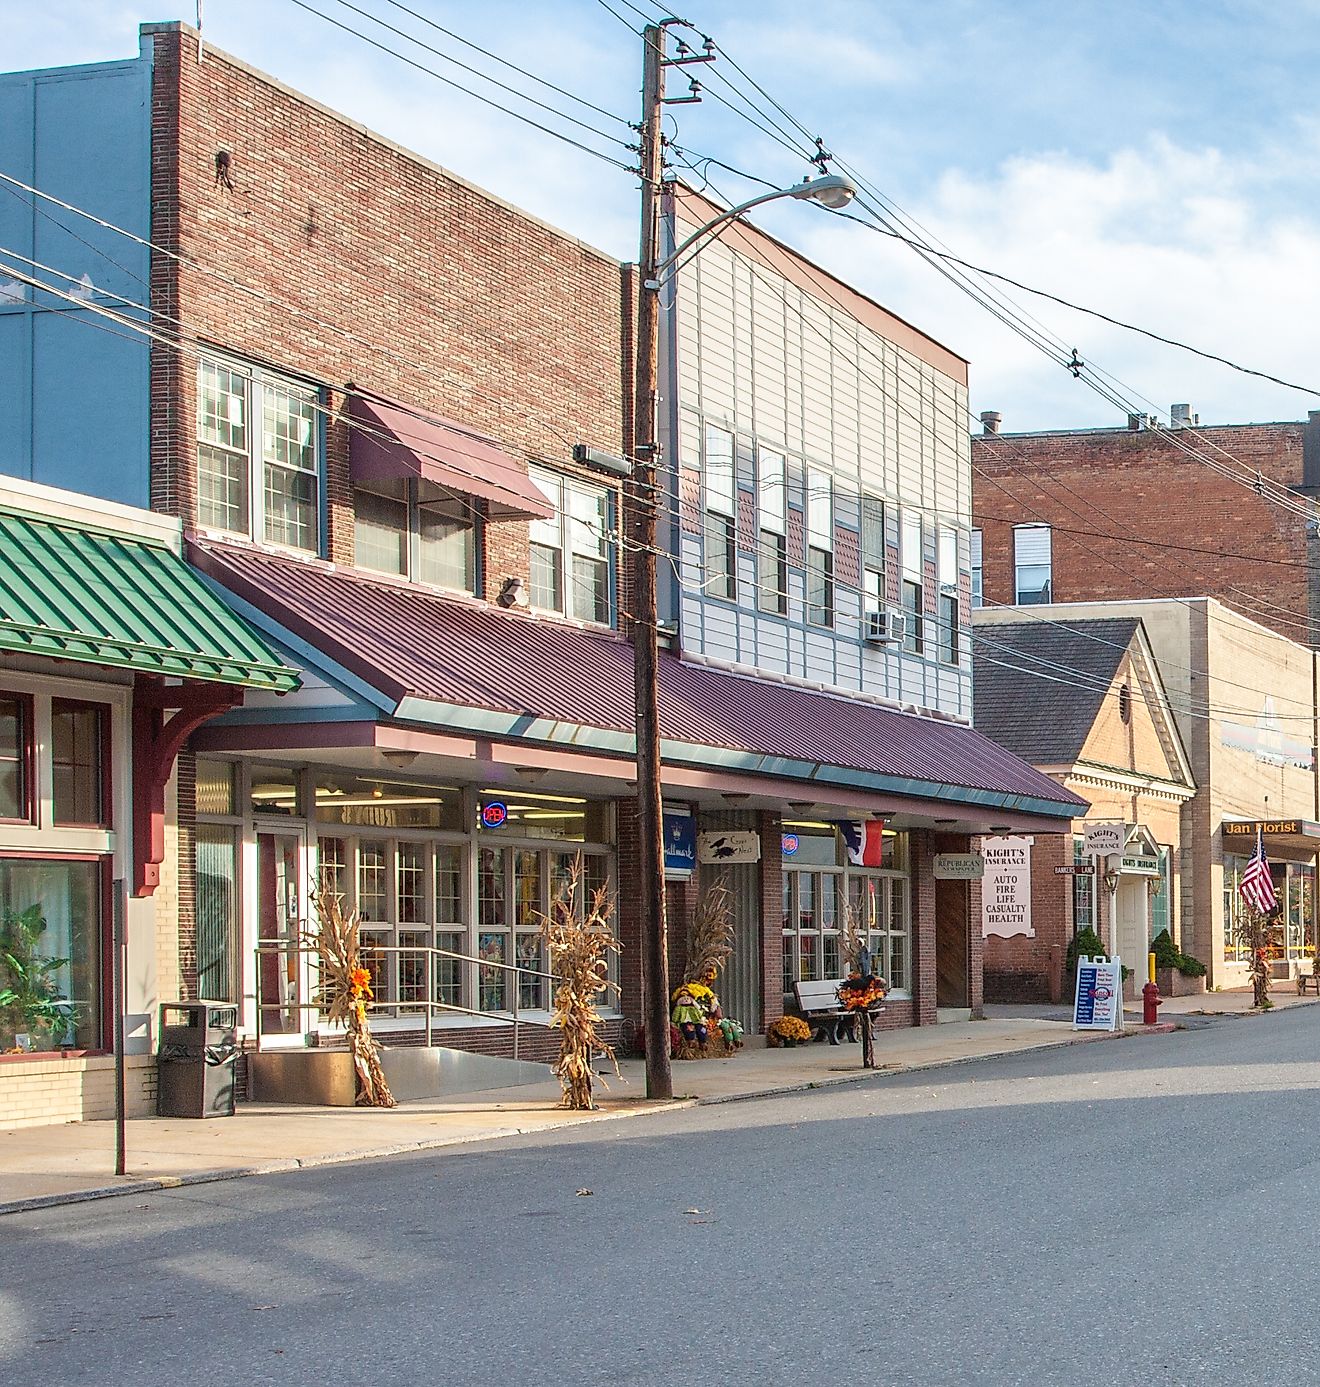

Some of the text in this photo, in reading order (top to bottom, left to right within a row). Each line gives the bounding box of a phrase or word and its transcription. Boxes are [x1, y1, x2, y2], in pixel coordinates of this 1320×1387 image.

[484, 807, 504, 822] OPEN
[1226, 821, 1297, 834] Jan Florist
[1087, 829, 1121, 841] KIGHT'S
[1086, 842, 1120, 850] INSURANCE
[664, 843, 695, 860] allmark
[986, 848, 1025, 858] KIGHT'S
[1054, 866, 1094, 874] BANKERS LANE
[993, 875, 1018, 884] AUTO
[996, 885, 1016, 894] FIRE
[996, 895, 1016, 904] LIFE
[985, 904, 1027, 914] CASUALTY
[988, 914, 1024, 923] HEALTH
